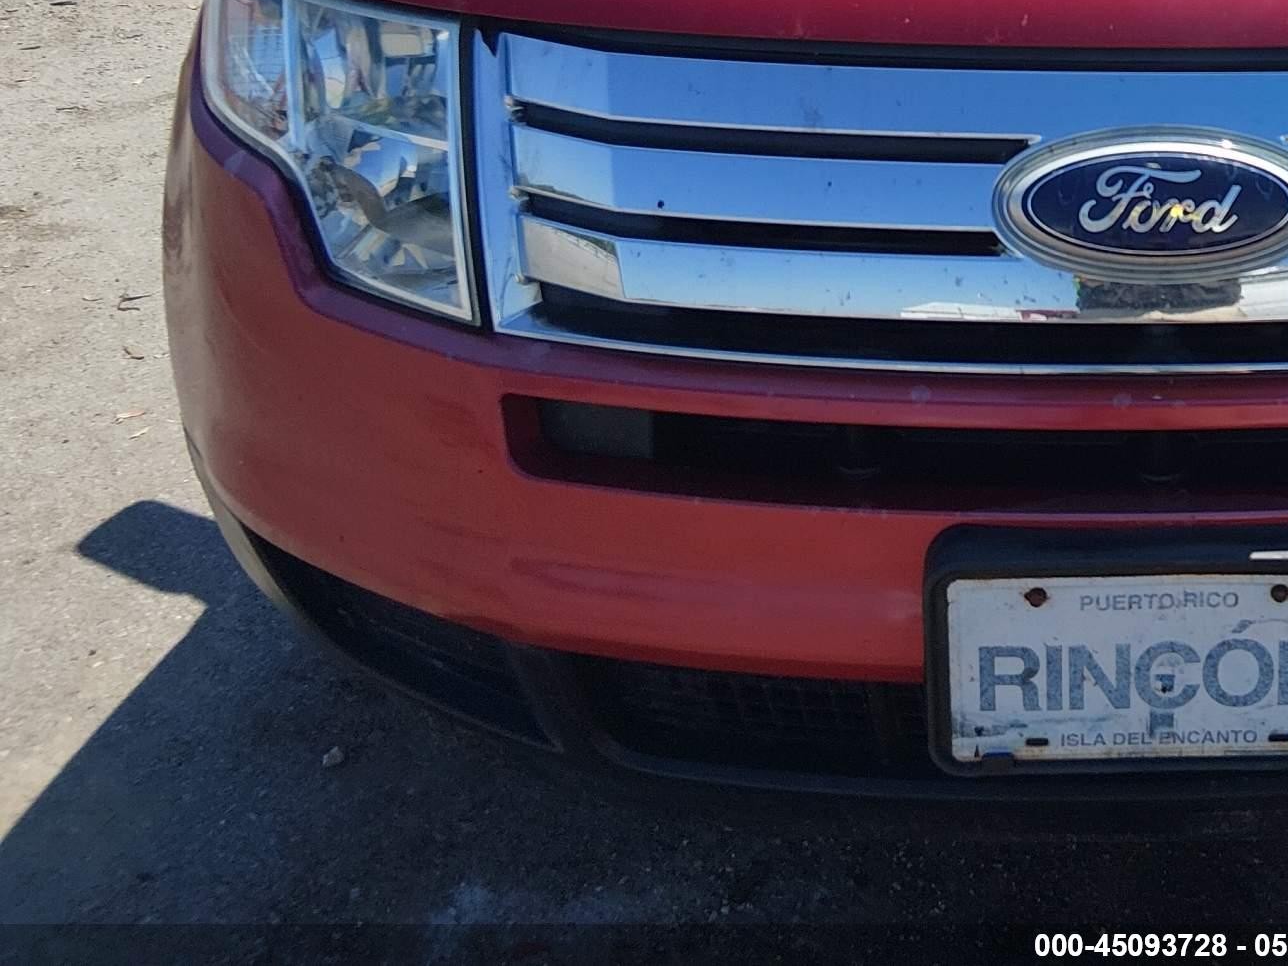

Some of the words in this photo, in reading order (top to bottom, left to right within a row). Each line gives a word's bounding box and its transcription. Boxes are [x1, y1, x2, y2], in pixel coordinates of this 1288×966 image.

[1078, 163, 1242, 233] Ford
[1079, 592, 1175, 611] PUERTO
[1184, 590, 1240, 609] RICO
[1060, 732, 1107, 747] ISLA
[1113, 731, 1153, 746] DEL
[1159, 729, 1258, 745] ENCANTO
